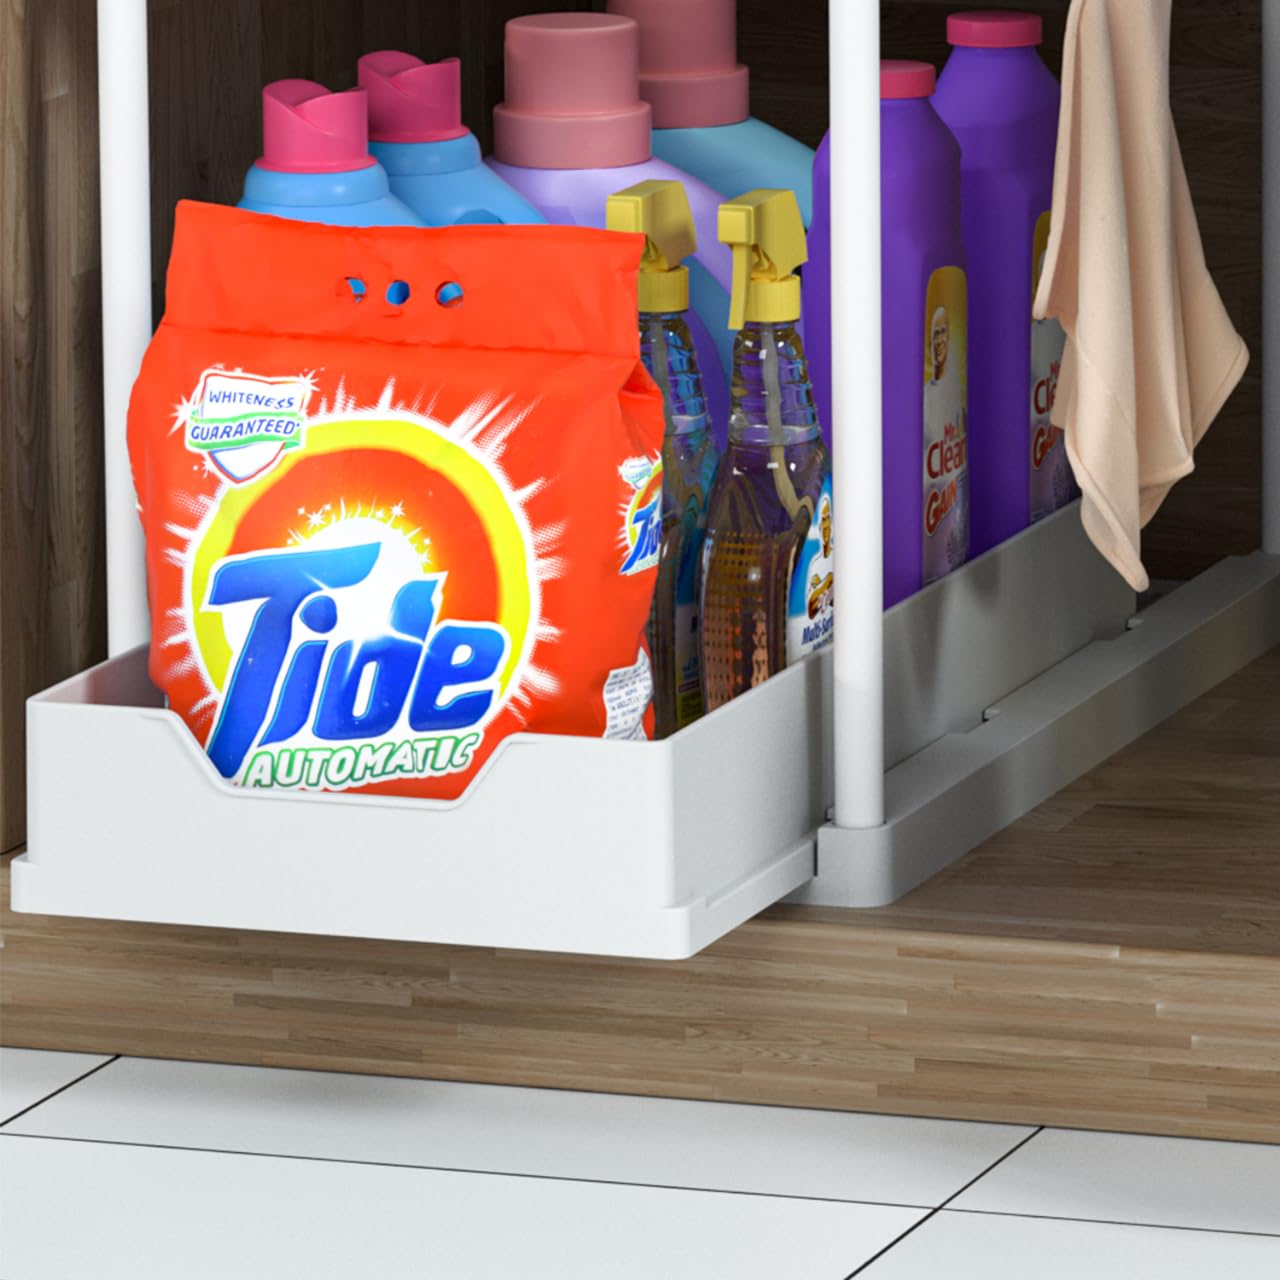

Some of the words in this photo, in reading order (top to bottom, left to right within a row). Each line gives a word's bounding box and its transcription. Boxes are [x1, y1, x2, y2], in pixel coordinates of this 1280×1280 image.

[208, 389, 295, 410] WHITENESS
[190, 418, 296, 442] GUARANTEED
[208, 541, 512, 779] Tide
[243, 733, 481, 790] AUTOMATIC
